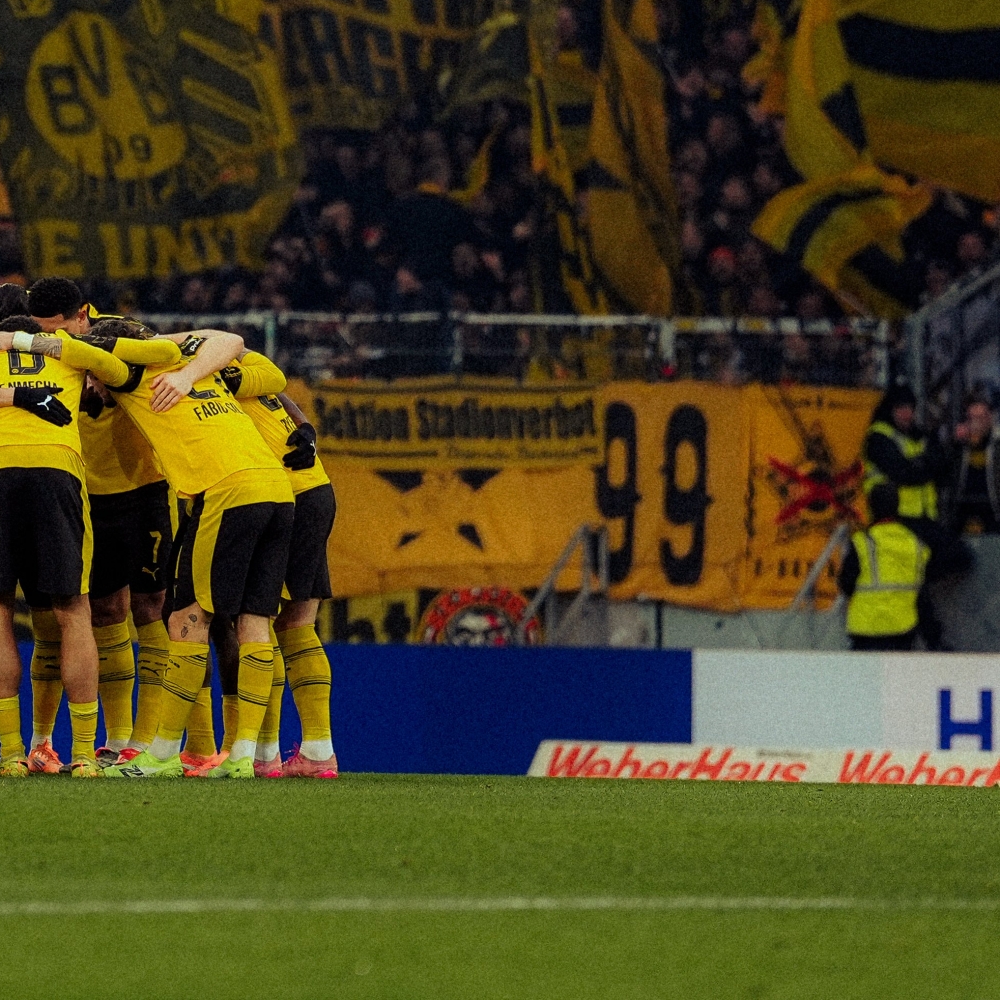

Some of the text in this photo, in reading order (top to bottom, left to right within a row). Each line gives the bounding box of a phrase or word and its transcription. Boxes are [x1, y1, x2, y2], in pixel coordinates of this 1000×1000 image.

[599, 401, 707, 586] 99
[150, 531, 162, 564] 7
[937, 687, 993, 752] H
